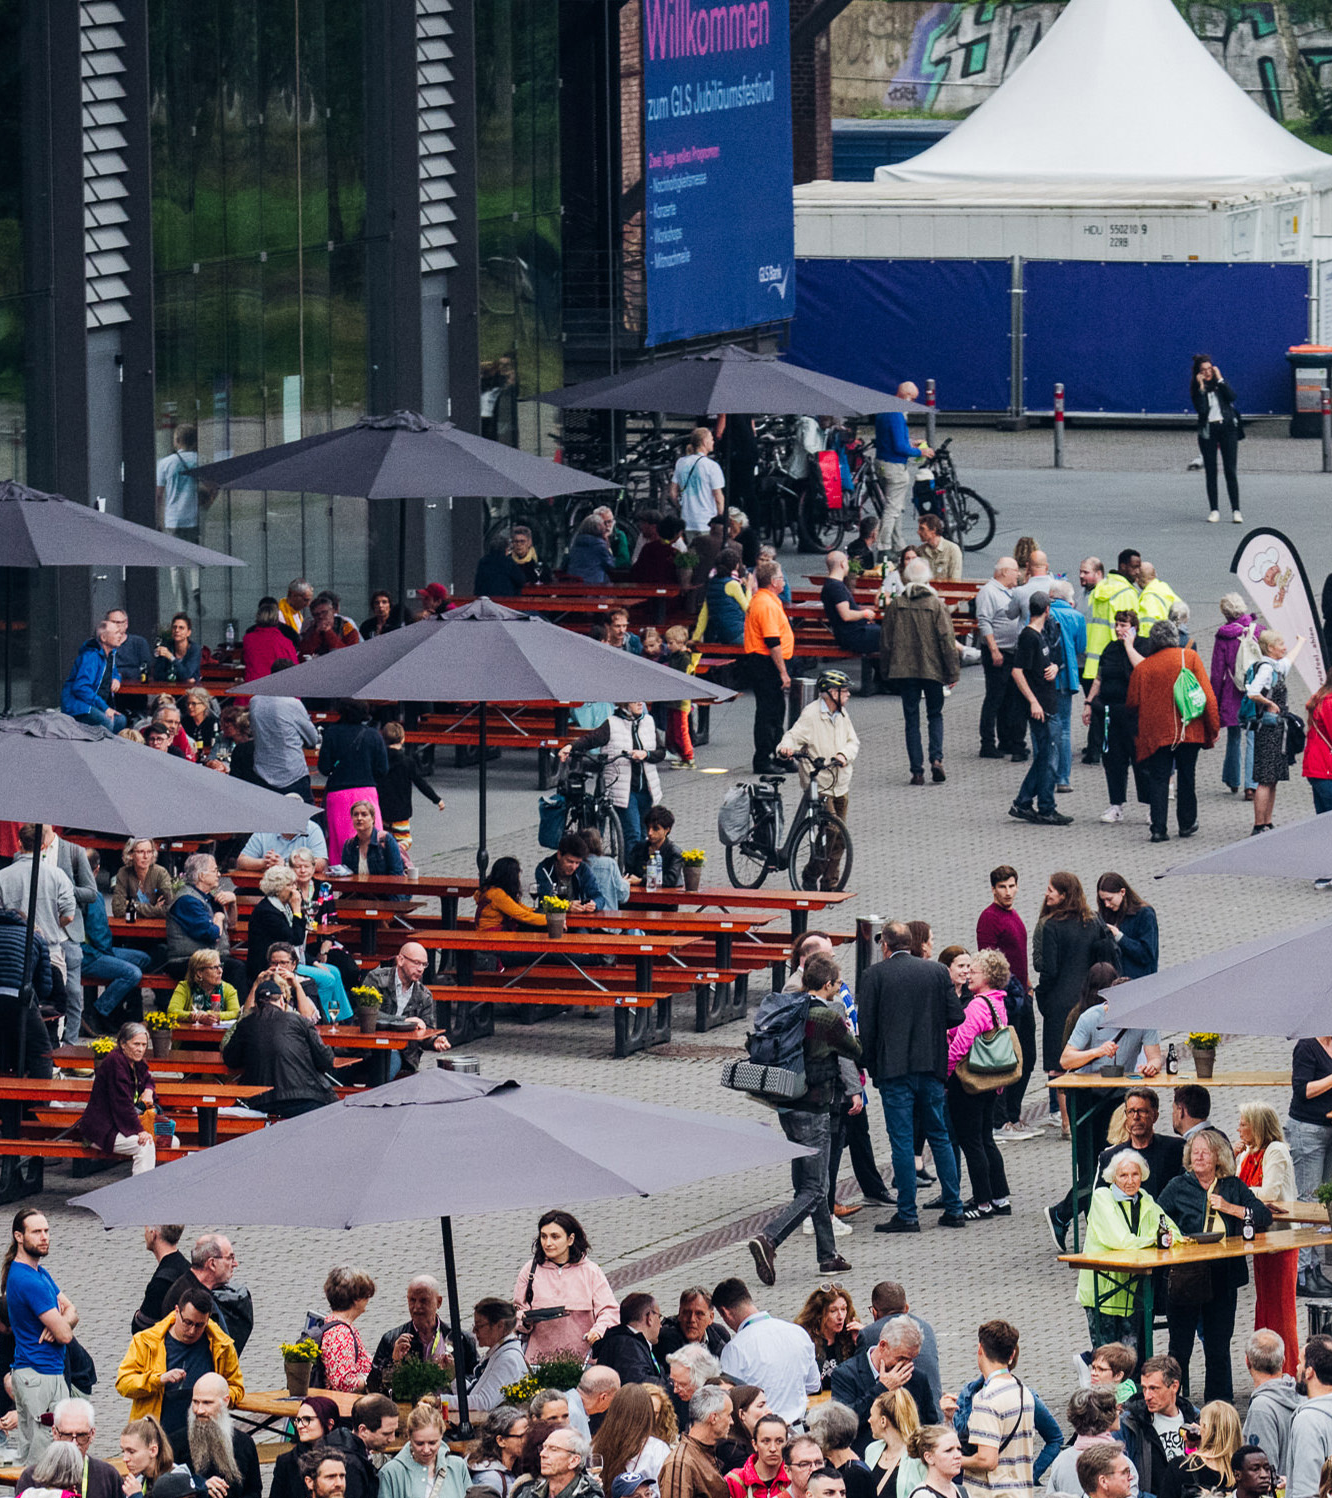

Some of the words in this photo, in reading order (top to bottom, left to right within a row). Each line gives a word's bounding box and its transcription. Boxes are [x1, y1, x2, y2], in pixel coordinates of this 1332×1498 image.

[646, 0, 770, 60] Willkommen
[648, 96, 670, 121] zum
[670, 83, 692, 118] GLS
[693, 70, 775, 114] Jubiläumsfestival
